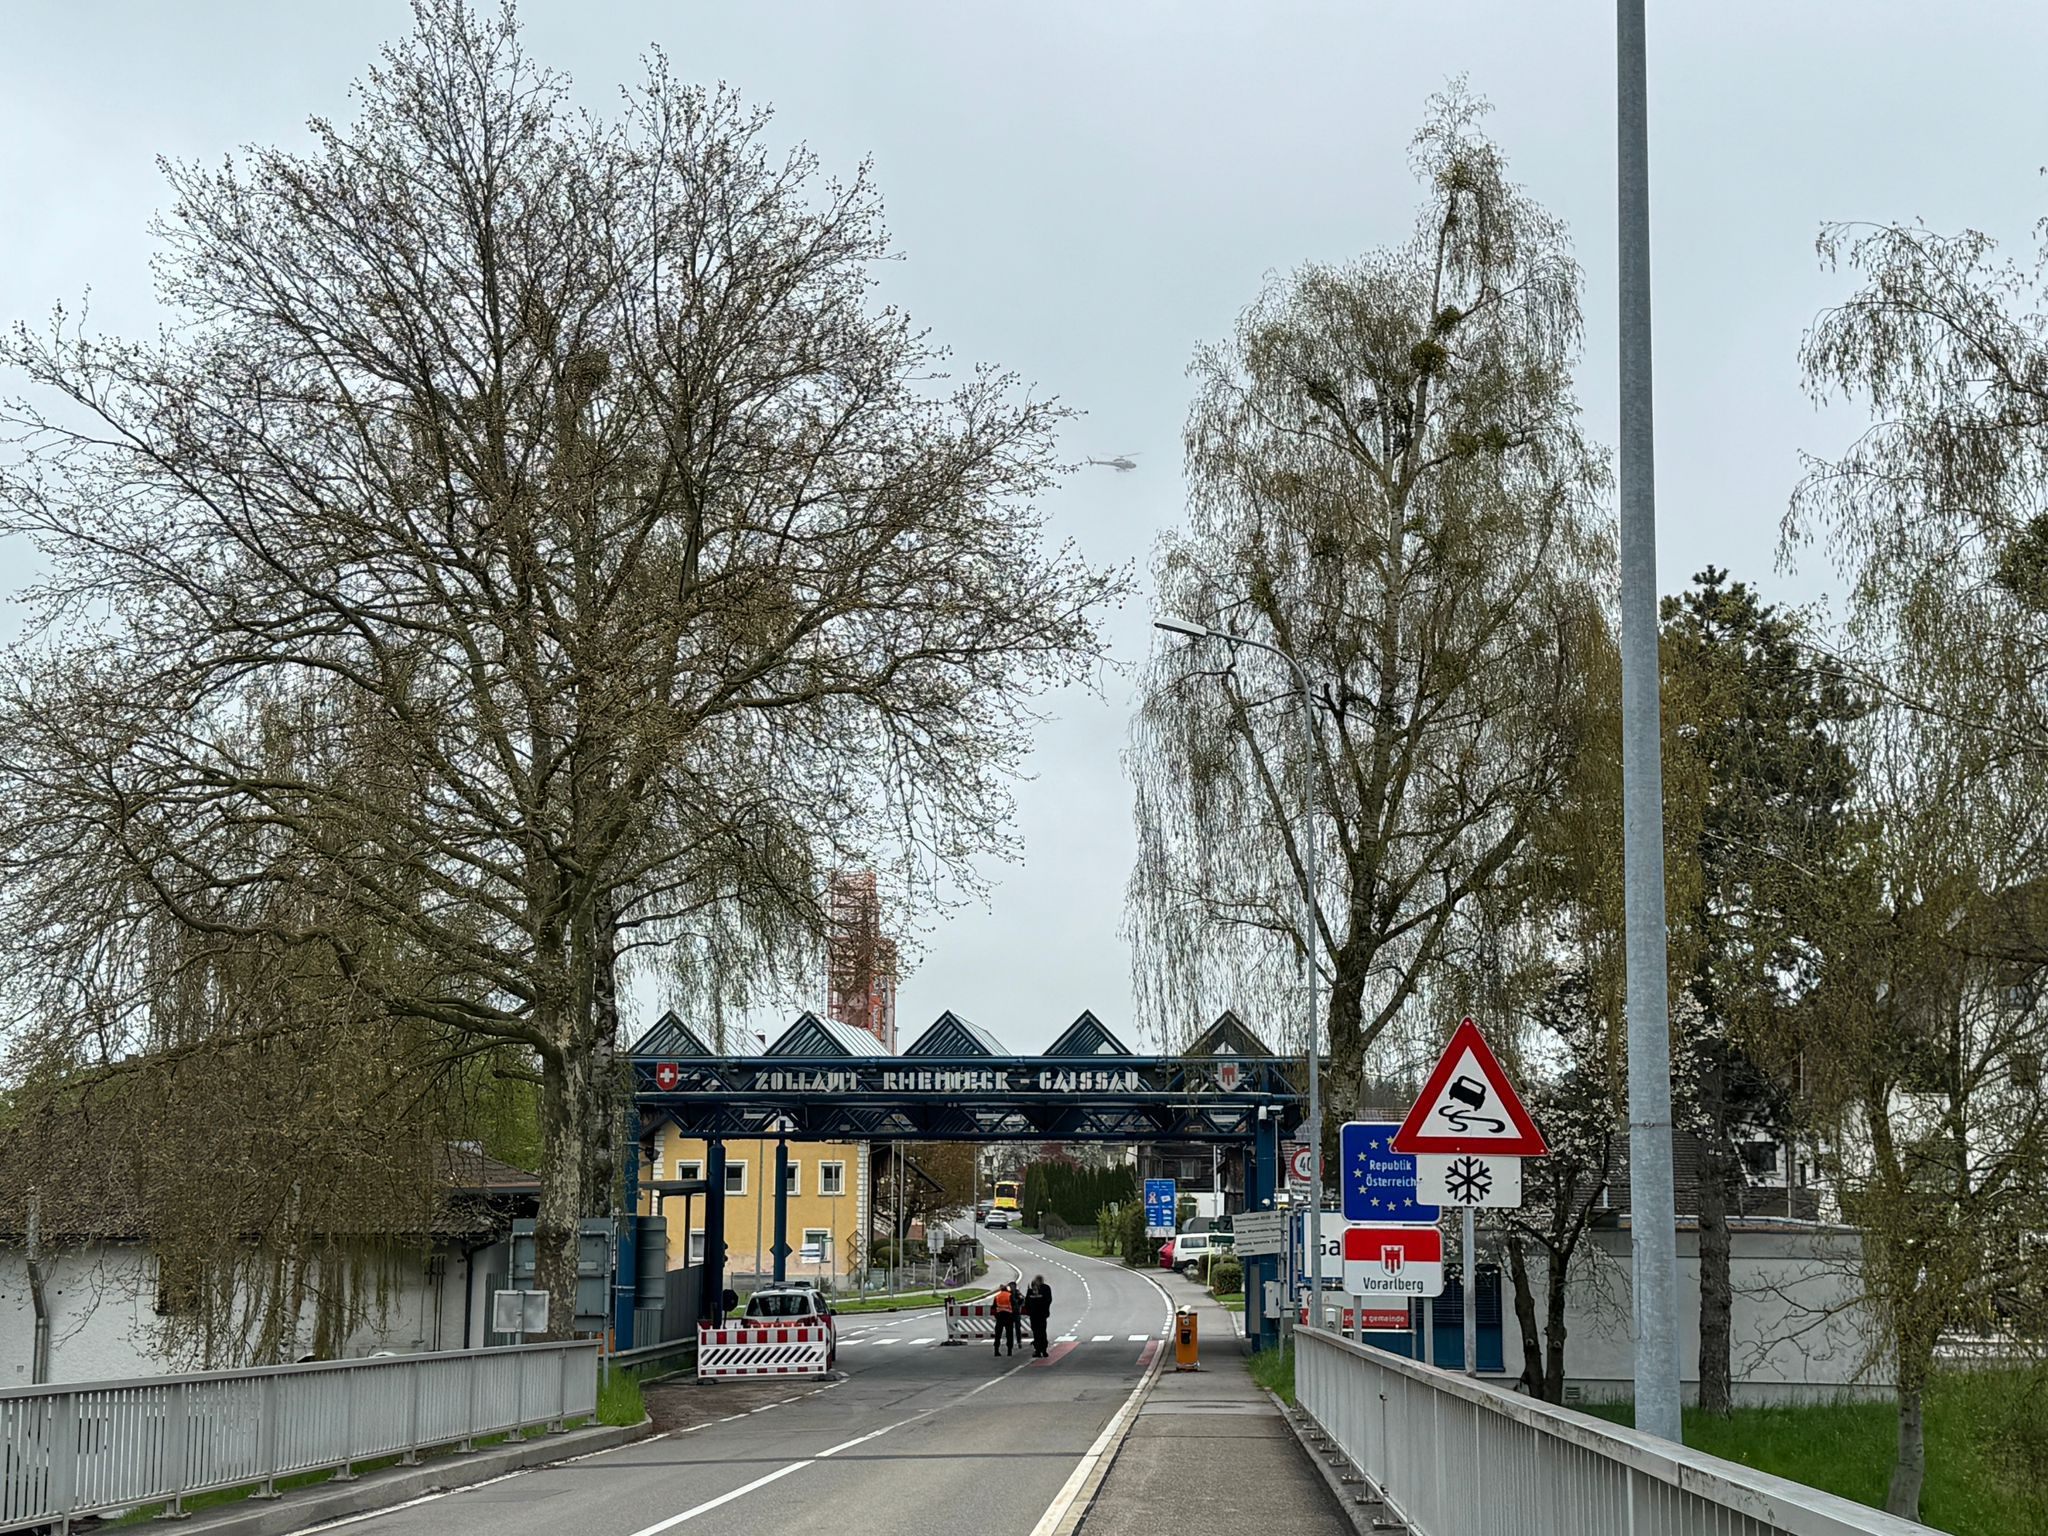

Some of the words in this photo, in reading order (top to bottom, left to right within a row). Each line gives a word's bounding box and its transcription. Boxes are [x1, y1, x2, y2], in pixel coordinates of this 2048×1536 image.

[1039, 1071, 1139, 1091] GAISSAU
[1299, 1156, 1311, 1172] 40
[1369, 1160, 1412, 1172] Republik
[1366, 1174, 1416, 1187] Österreich
[1363, 1277, 1424, 1293] Vorarlberg
